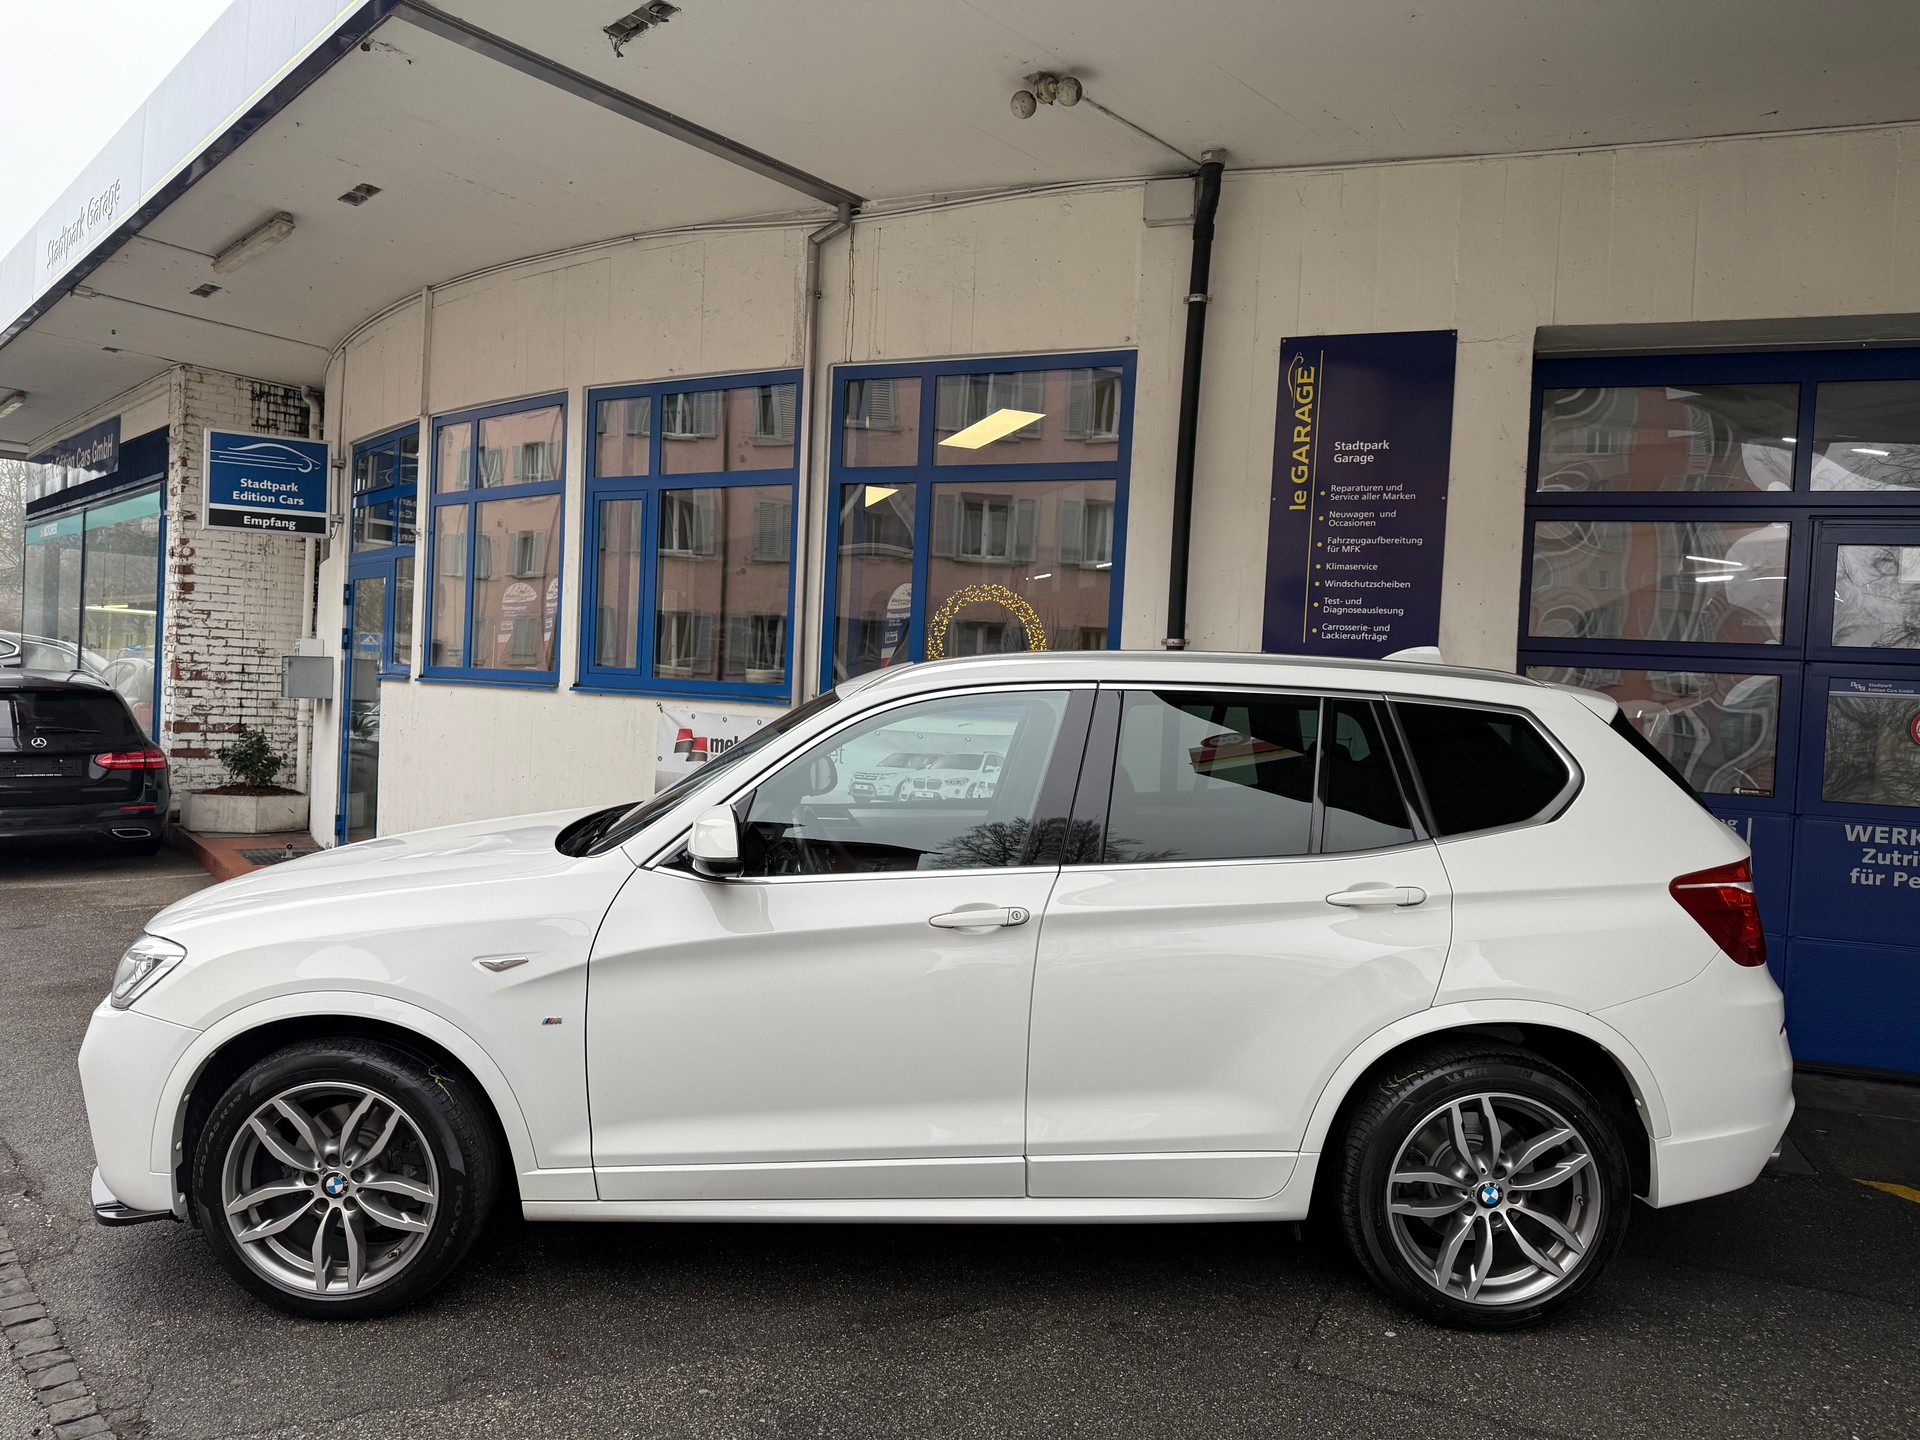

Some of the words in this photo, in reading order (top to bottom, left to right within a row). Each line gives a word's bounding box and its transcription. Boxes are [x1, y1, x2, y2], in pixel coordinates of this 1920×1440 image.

[46, 206, 85, 270] Stadtpark
[86, 178, 121, 230] Garage
[1290, 366, 1315, 484] GARAGE
[76, 447, 91, 468] Cars
[91, 433, 114, 463] GmbH
[1334, 439, 1390, 452] Stadtpark
[1333, 453, 1375, 465] Garage
[240, 478, 298, 492] Stadtpark
[1330, 484, 1383, 493] Reparaturen
[1385, 483, 1403, 491] und
[232, 491, 275, 503] Edition
[279, 495, 304, 506] Cars
[1289, 490, 1308, 511] le
[1330, 493, 1359, 501] Service
[1361, 492, 1380, 500] aller
[1382, 492, 1416, 500] Marken
[1329, 510, 1375, 519] Neuwagen
[1379, 510, 1397, 518] und
[243, 515, 297, 531] Empfang
[1328, 519, 1376, 527] Occasionen
[1327, 536, 1423, 546] Fahrzeugaufbereitung
[1327, 545, 1340, 553] für
[1341, 545, 1361, 553] MFK
[1325, 562, 1378, 571] Klimaservice
[1324, 580, 1411, 588] Windschutzscheiben
[1323, 597, 1343, 605] Test-
[1345, 597, 1362, 605] und
[1323, 605, 1404, 616] Diagnoseauslesung
[1322, 623, 1371, 631] Carrosserie-
[1373, 624, 1390, 632] und
[1321, 632, 1388, 642] Lackieraufträge
[1861, 848, 1920, 867] Zutri
[1850, 867, 1886, 886] für
[1893, 871, 1920, 889] Pe
